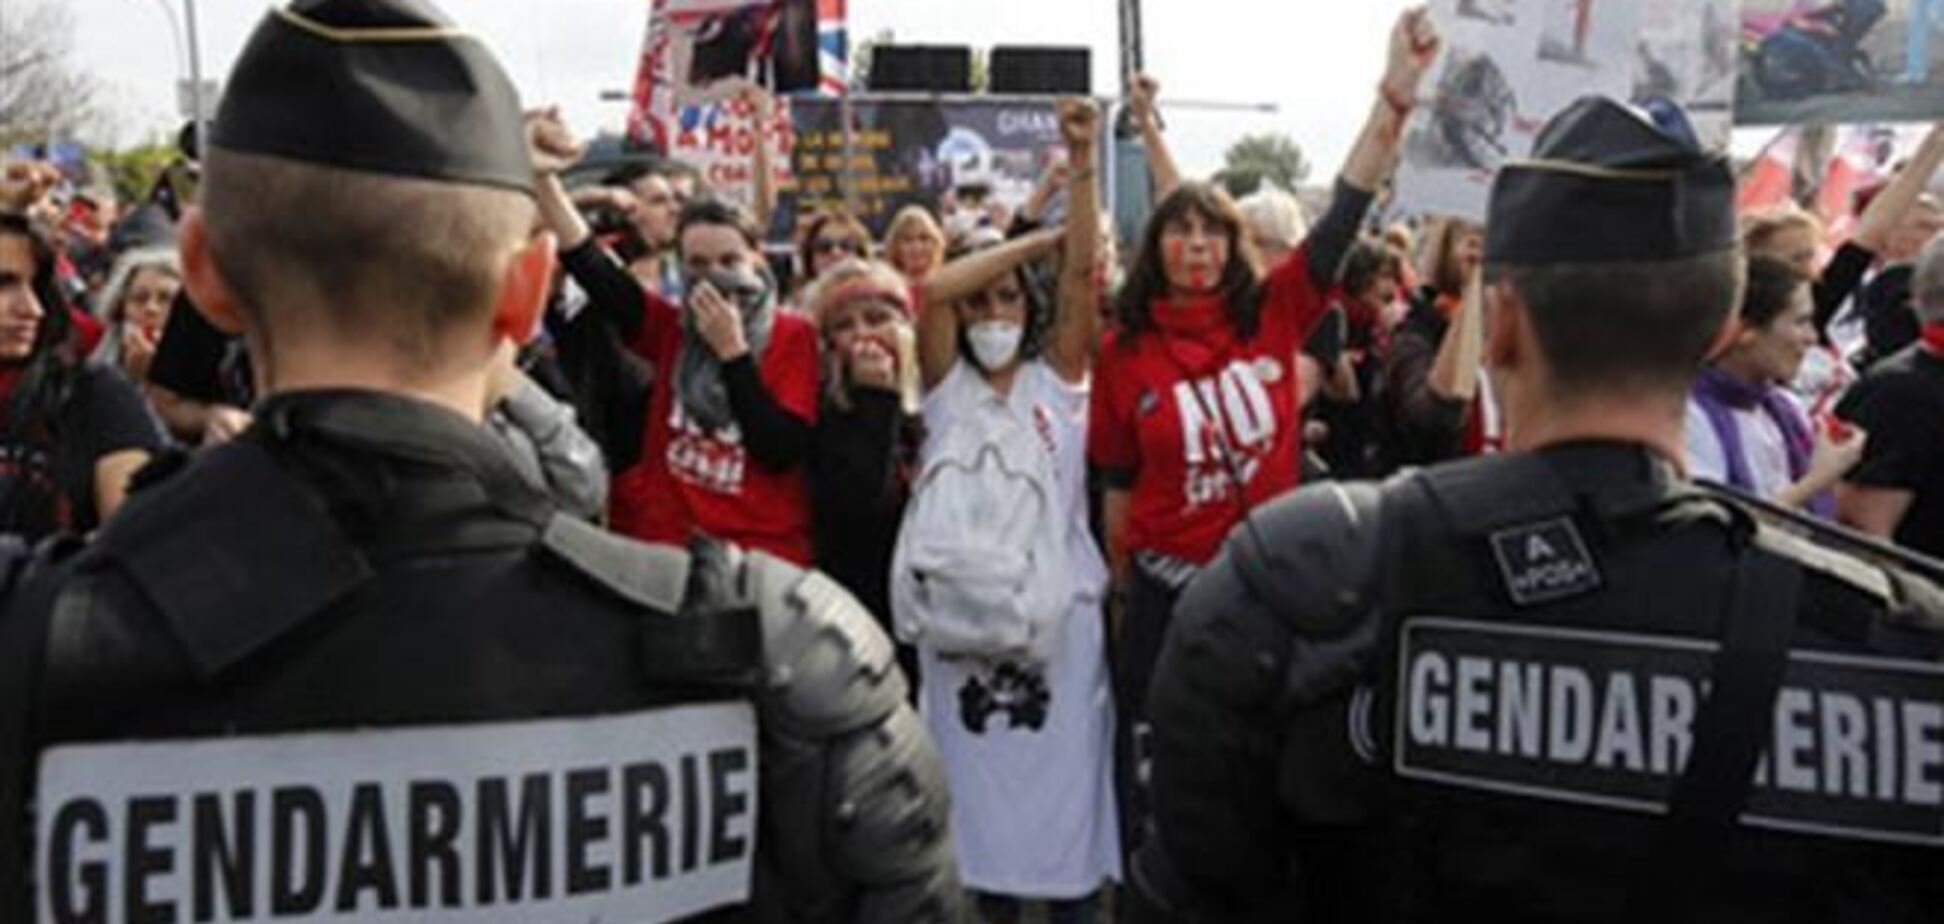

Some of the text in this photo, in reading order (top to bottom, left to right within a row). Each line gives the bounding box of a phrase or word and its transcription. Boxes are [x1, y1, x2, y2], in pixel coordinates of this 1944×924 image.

[1173, 360, 1276, 463] NO
[1526, 533, 1554, 560] A
[1409, 651, 1944, 804] GENDARERIE
[47, 747, 749, 924] GENDARMERIE
